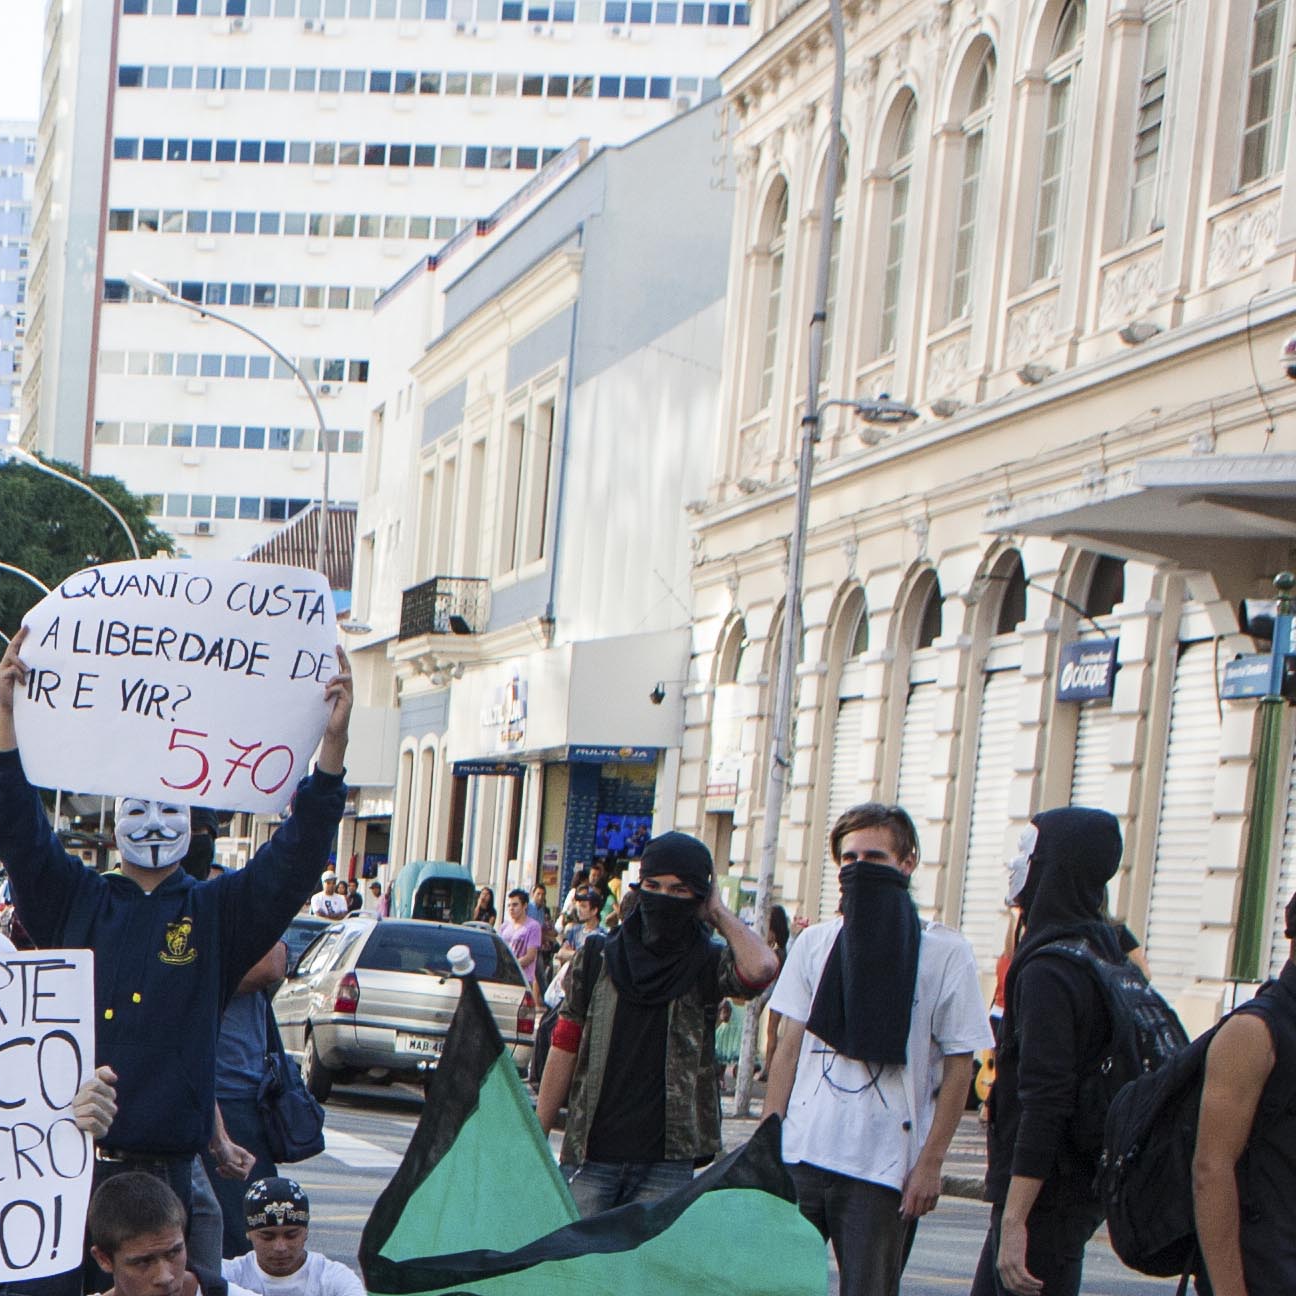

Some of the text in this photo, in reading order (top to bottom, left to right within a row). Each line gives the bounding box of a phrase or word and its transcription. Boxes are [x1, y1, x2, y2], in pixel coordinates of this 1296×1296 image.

[59, 568, 325, 625] QUANTO CUSTA
[40, 617, 334, 684] A LIBERDADE DE
[26, 669, 191, 723] IR E VIR?
[160, 728, 295, 796] 5,70
